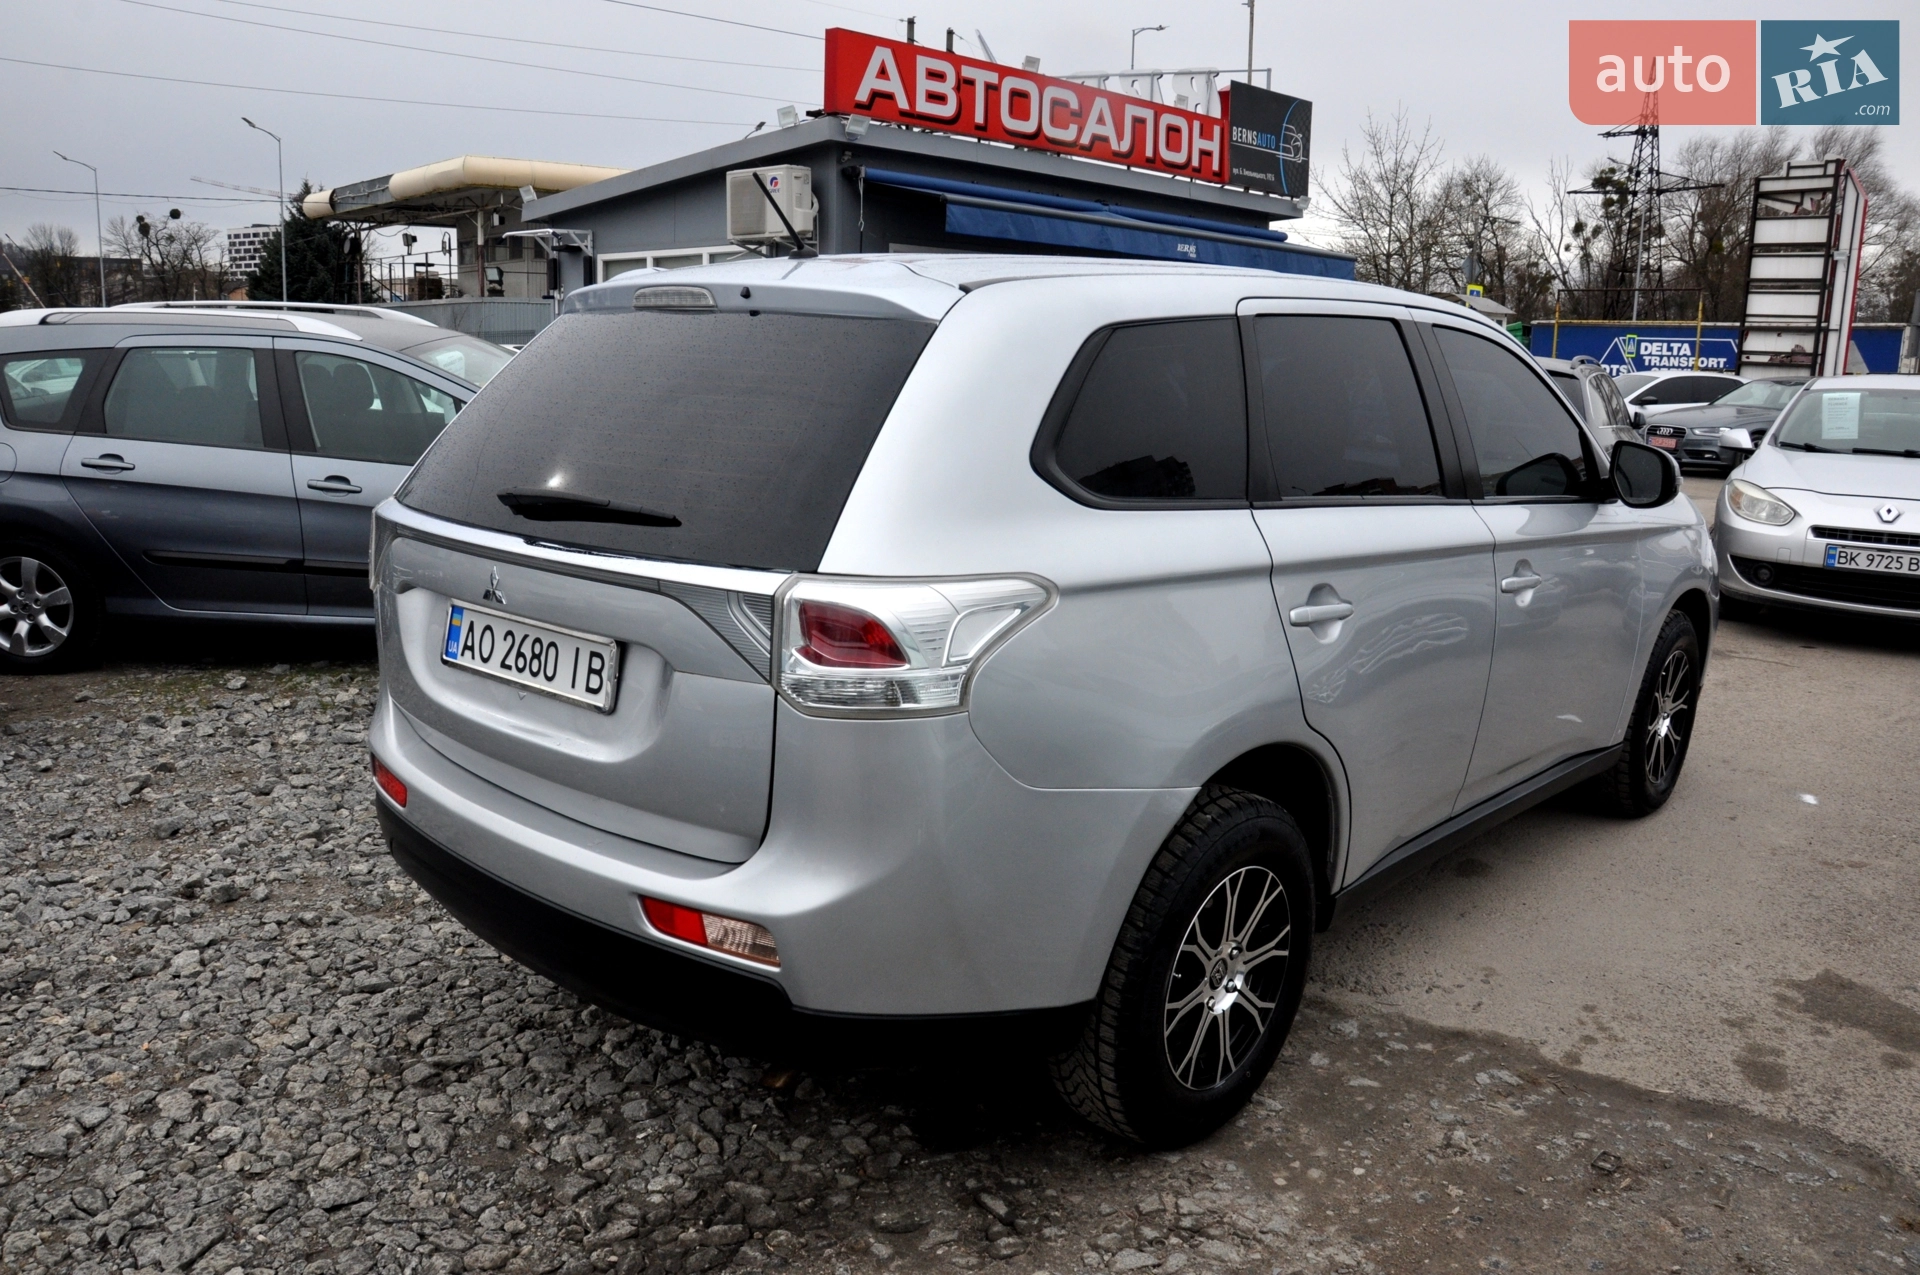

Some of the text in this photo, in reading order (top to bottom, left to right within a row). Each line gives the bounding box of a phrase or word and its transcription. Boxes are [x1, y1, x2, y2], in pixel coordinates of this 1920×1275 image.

[854, 45, 1222, 173] АВТОСАЛОН
[1232, 126, 1276, 149] BERNSAUTO
[1640, 342, 1692, 356] DELTA
[1643, 355, 1727, 368] TRANSPORT
[1837, 551, 1861, 567] BK
[1866, 553, 1904, 570] 9725
[448, 640, 458, 654] UA
[460, 620, 605, 695] AO 2680 IB
